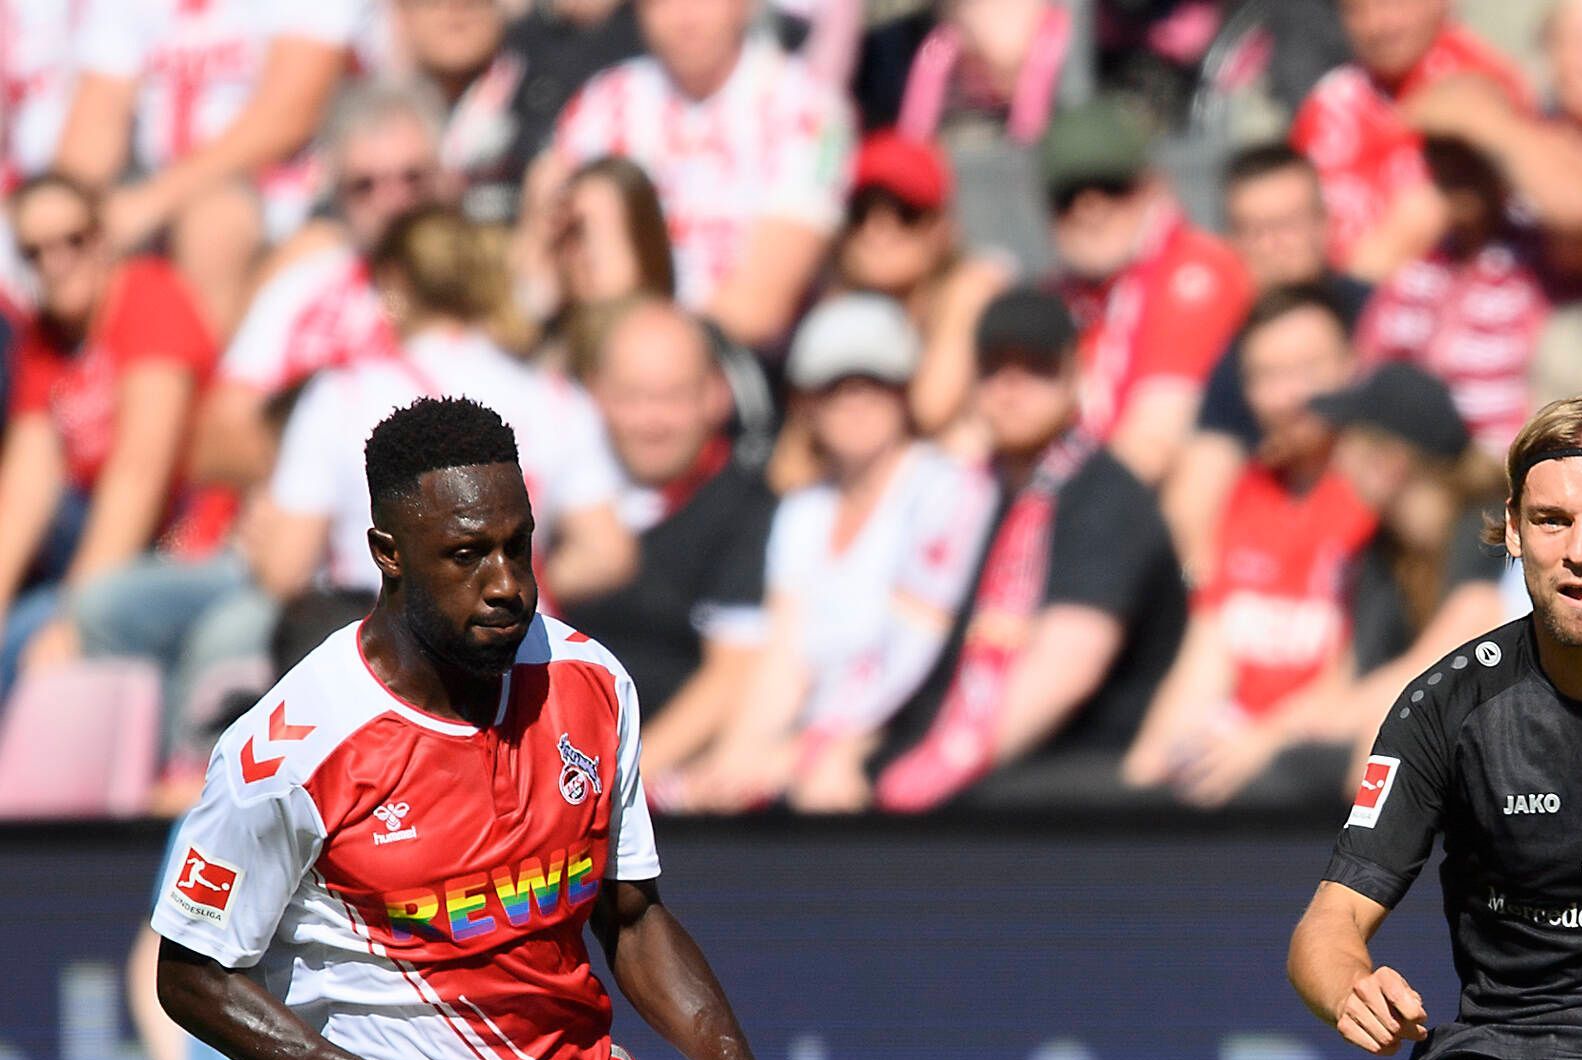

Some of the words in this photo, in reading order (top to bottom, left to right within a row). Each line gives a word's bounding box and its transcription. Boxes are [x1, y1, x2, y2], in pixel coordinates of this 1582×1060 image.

[1503, 793, 1561, 815] JAKO
[373, 825, 418, 846] hummel
[384, 841, 599, 942] REWE
